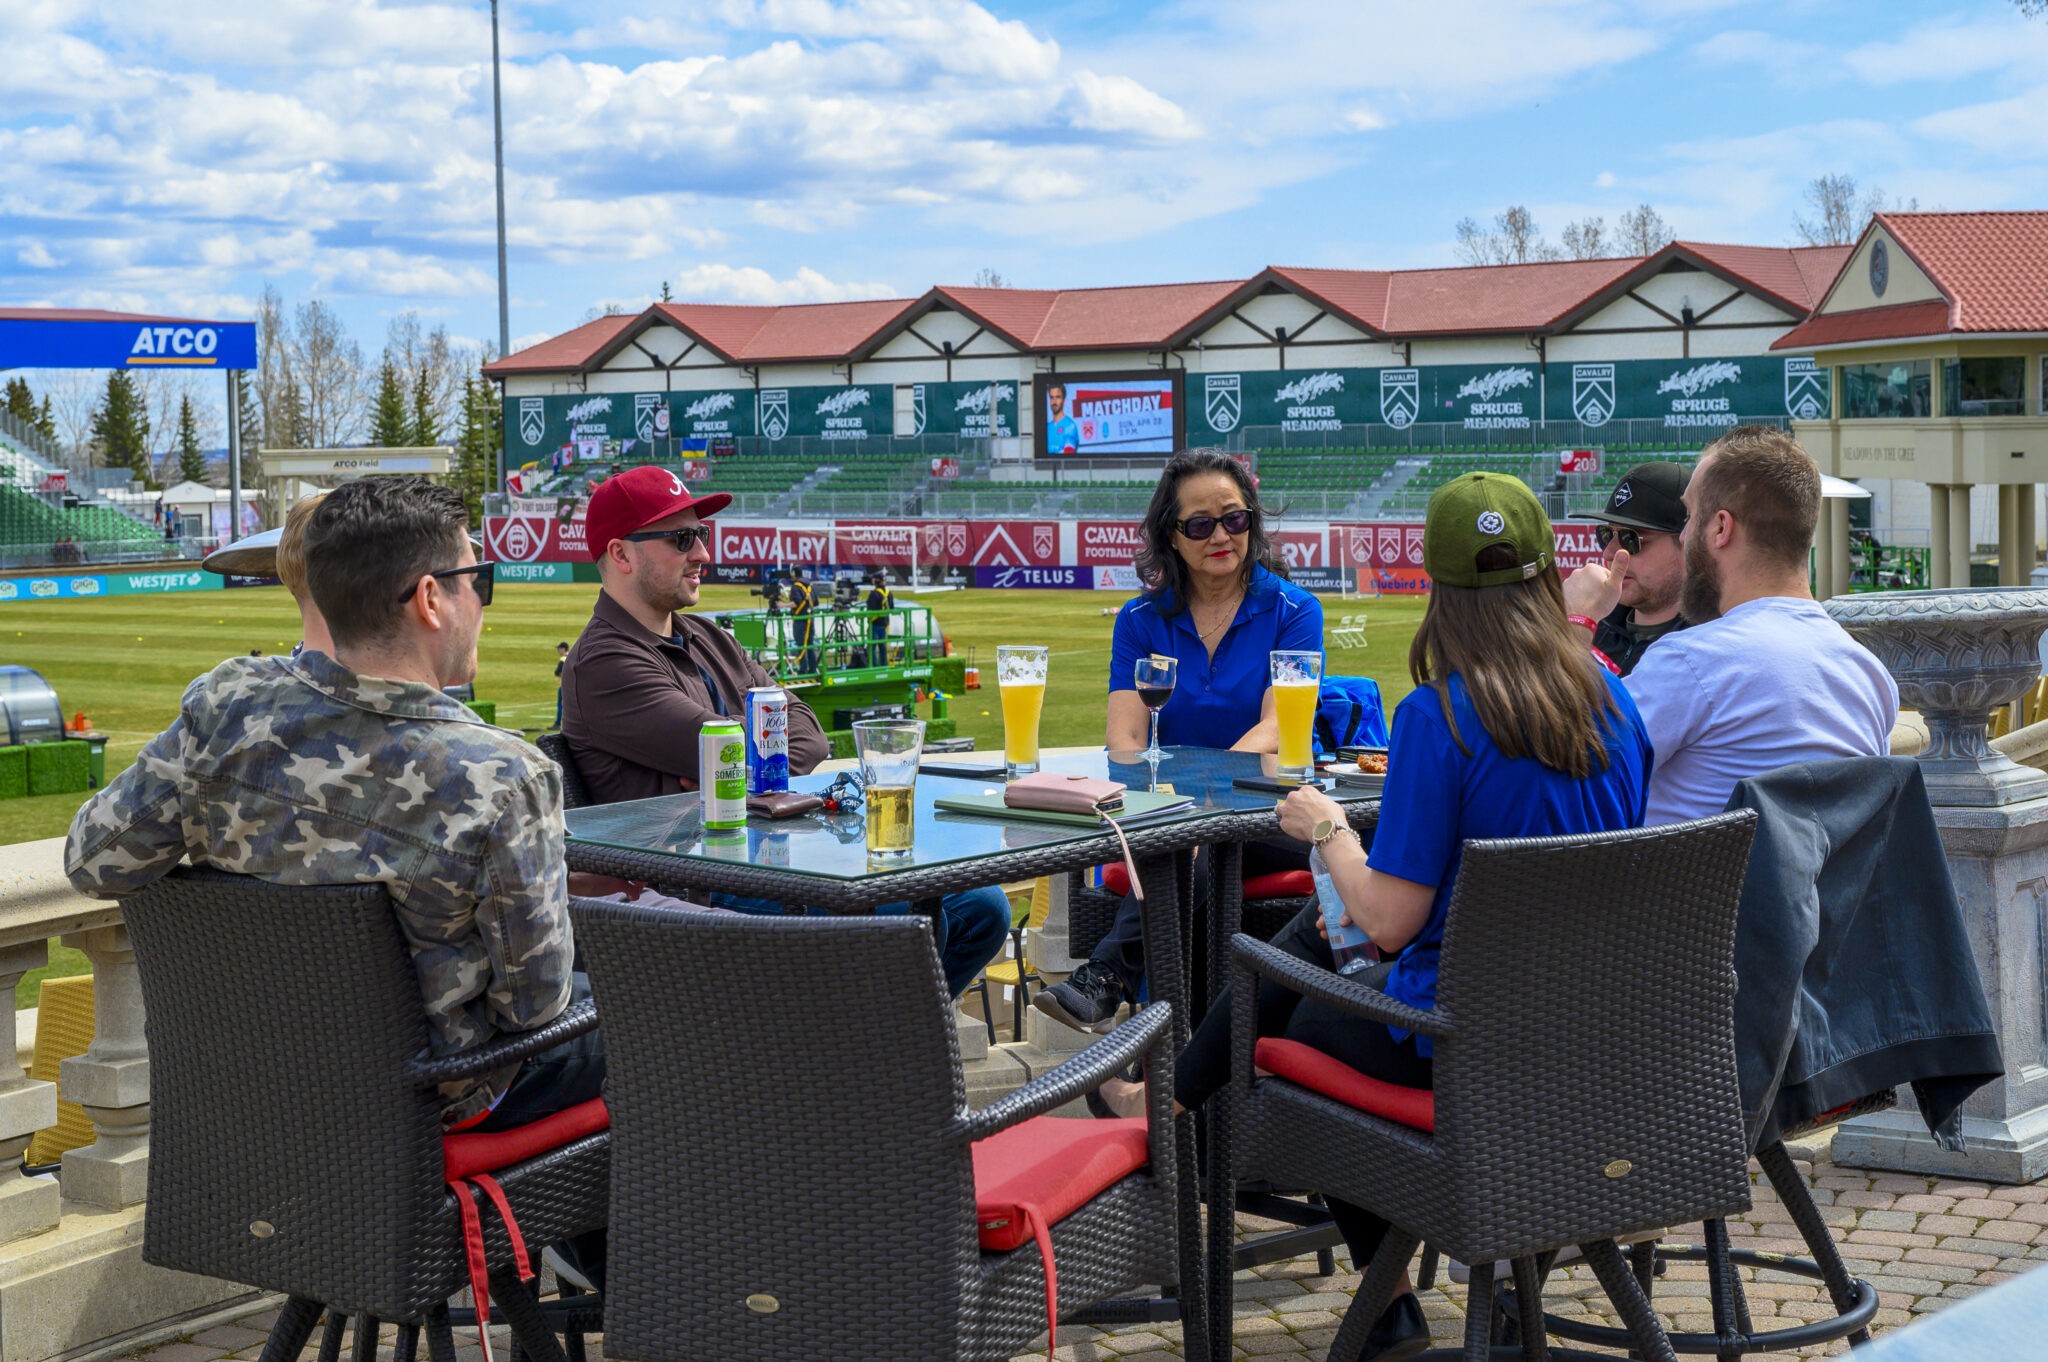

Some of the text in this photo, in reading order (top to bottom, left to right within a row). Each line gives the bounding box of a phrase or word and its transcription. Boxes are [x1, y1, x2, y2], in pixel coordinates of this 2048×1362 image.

[131, 327, 217, 355] ATCO
[1789, 361, 1819, 371] CAVAL
[1383, 373, 1416, 382] CAVALRY
[1576, 368, 1612, 377] CAVALRY
[1208, 378, 1238, 387] CAVALRY
[1081, 395, 1161, 417] MATCHDAY
[1470, 402, 1523, 415] SPRUCE
[1672, 398, 1730, 412] SPRUCE
[1287, 406, 1335, 418] SPRUCE
[693, 420, 729, 432] SPRUCE
[825, 417, 862, 428] SPRUCE
[1281, 419, 1342, 432] MEADOWS
[1464, 416, 1530, 429] MEADOWS
[1664, 413, 1738, 427] MEADOWS
[821, 429, 868, 440] MEADOWS
[333, 459, 378, 468] ATCO Field
[1573, 458, 1597, 471] 203
[1085, 527, 1143, 544] CAVAL
[723, 534, 828, 560] CAVALRY
[852, 545, 915, 555] FOOTBALL CLU
[1085, 547, 1134, 558] FOOTBALL
[500, 565, 544, 580] WESTJET
[717, 567, 748, 579] tonybet
[1023, 570, 1075, 583] TELUS
[129, 574, 185, 591] WESTJET
[1370, 577, 1416, 589] Bluebird
[766, 716, 786, 728] 1664
[760, 740, 787, 749] BLAN
